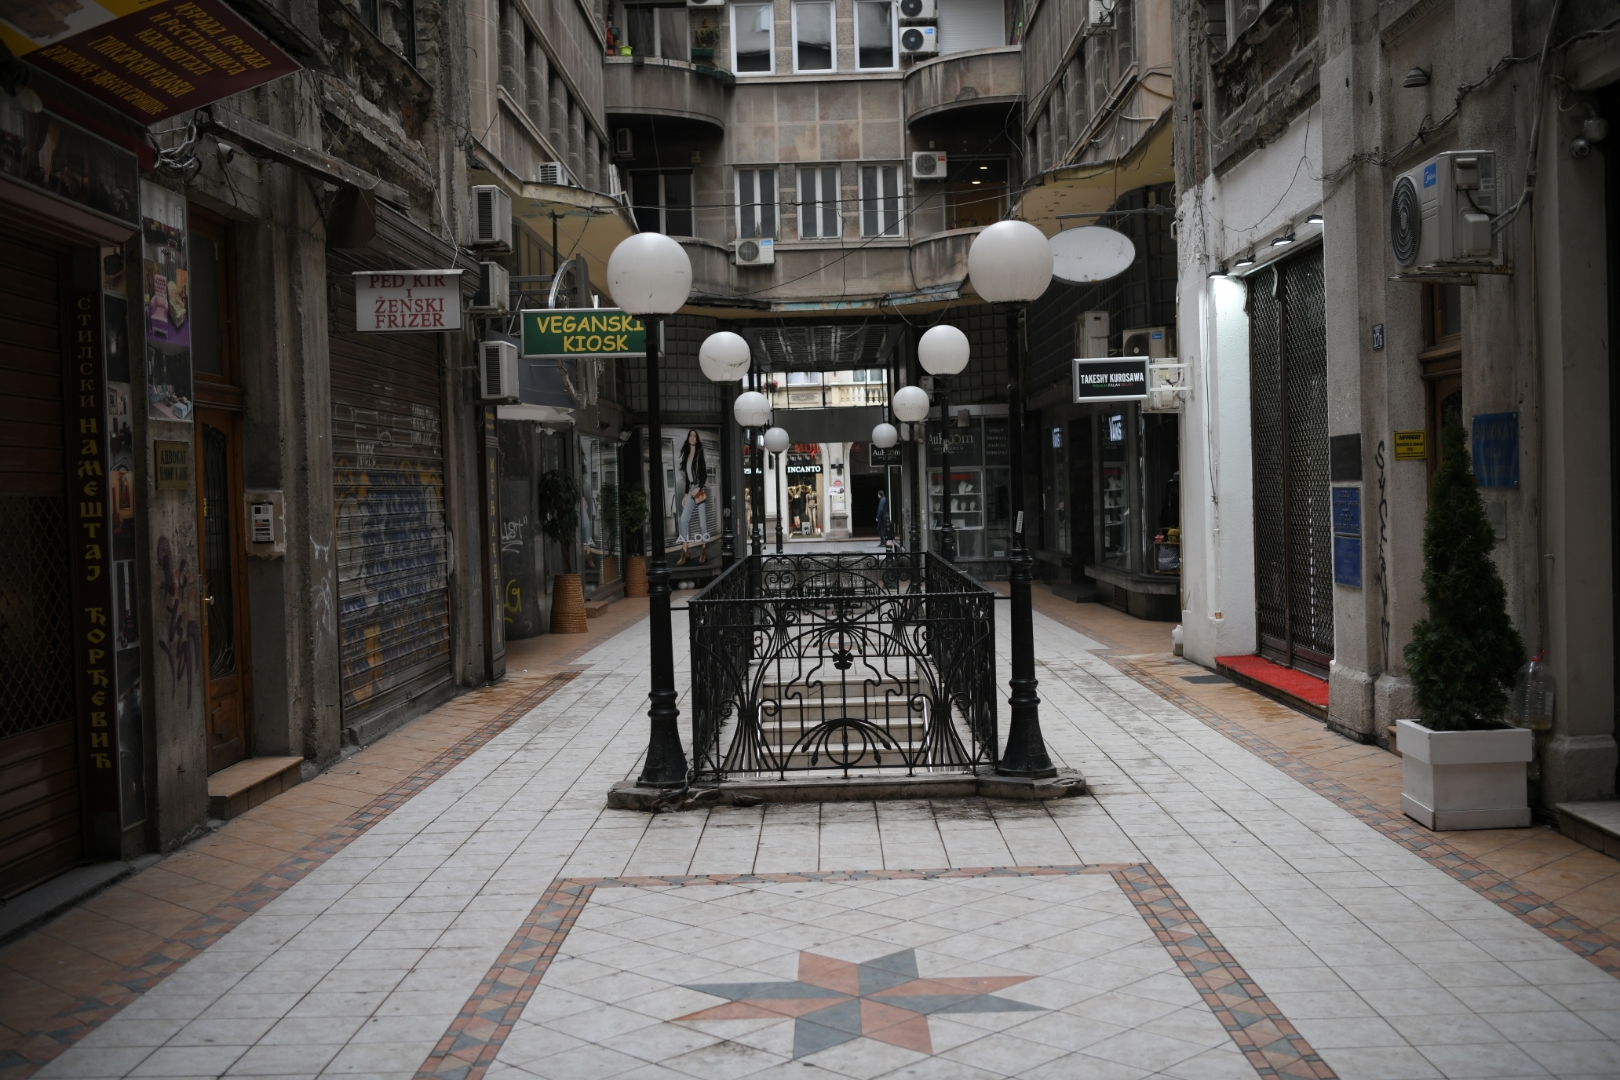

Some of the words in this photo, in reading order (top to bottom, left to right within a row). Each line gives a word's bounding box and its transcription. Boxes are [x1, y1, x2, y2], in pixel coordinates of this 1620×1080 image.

[149, 12, 171, 22] И
[174, 2, 227, 37] ИЗРАДА,
[218, 34, 272, 69] ПРЕРАДА
[135, 28, 213, 76] НАМЕШТАЈА
[159, 18, 247, 76] РЕСТАУРАЦИЈА
[144, 68, 196, 97] РАДОВИ
[406, 289, 412, 298] I
[375, 296, 444, 313] ŽENSKI
[375, 313, 445, 328] FRIZER
[536, 315, 644, 333] VEGANSKI
[564, 334, 628, 352] KIOSK
[77, 297, 96, 408] СТИЛСКИ
[1081, 374, 1108, 384] TAKESHY
[1110, 372, 1144, 382] KUROSAWA
[1476, 422, 1515, 440] ADVOKAT
[161, 451, 186, 464] АДВОКАТ
[77, 418, 103, 581] НАМЕШТАЈ
[676, 533, 710, 543] ALDO
[84, 607, 112, 768] ЂОРЂЕВИЋ
